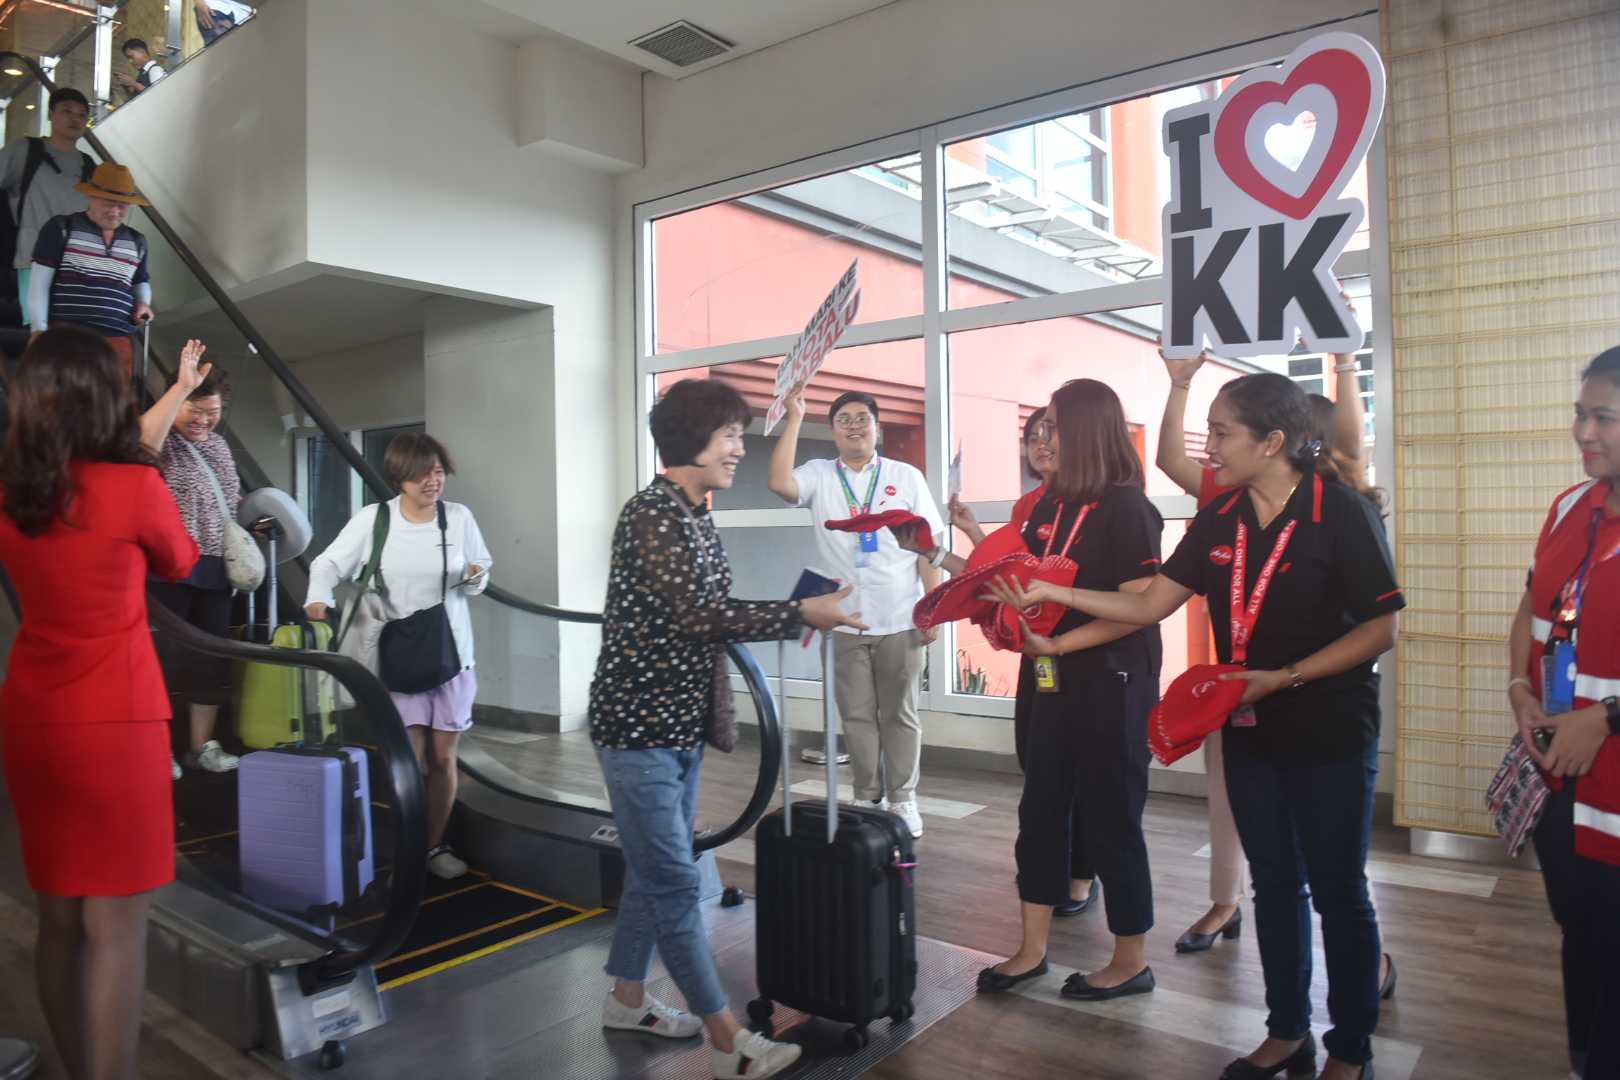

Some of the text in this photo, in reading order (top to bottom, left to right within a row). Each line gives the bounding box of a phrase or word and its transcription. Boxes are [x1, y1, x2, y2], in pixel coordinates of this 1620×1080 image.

[1168, 113, 1212, 234] I
[1171, 212, 1352, 347] KK
[777, 338, 801, 381] BAH
[804, 288, 836, 341] MARI
[838, 261, 857, 296] KE
[791, 307, 837, 380] KOTA
[767, 293, 859, 430] KIABALU
[1276, 531, 1289, 551] ONE
[1235, 548, 1244, 567] ONE
[1263, 557, 1277, 577] ONE
[1233, 568, 1243, 587] FOR
[1254, 577, 1269, 597] FOR
[1232, 588, 1242, 606] ALL
[1248, 598, 1261, 615] ALL
